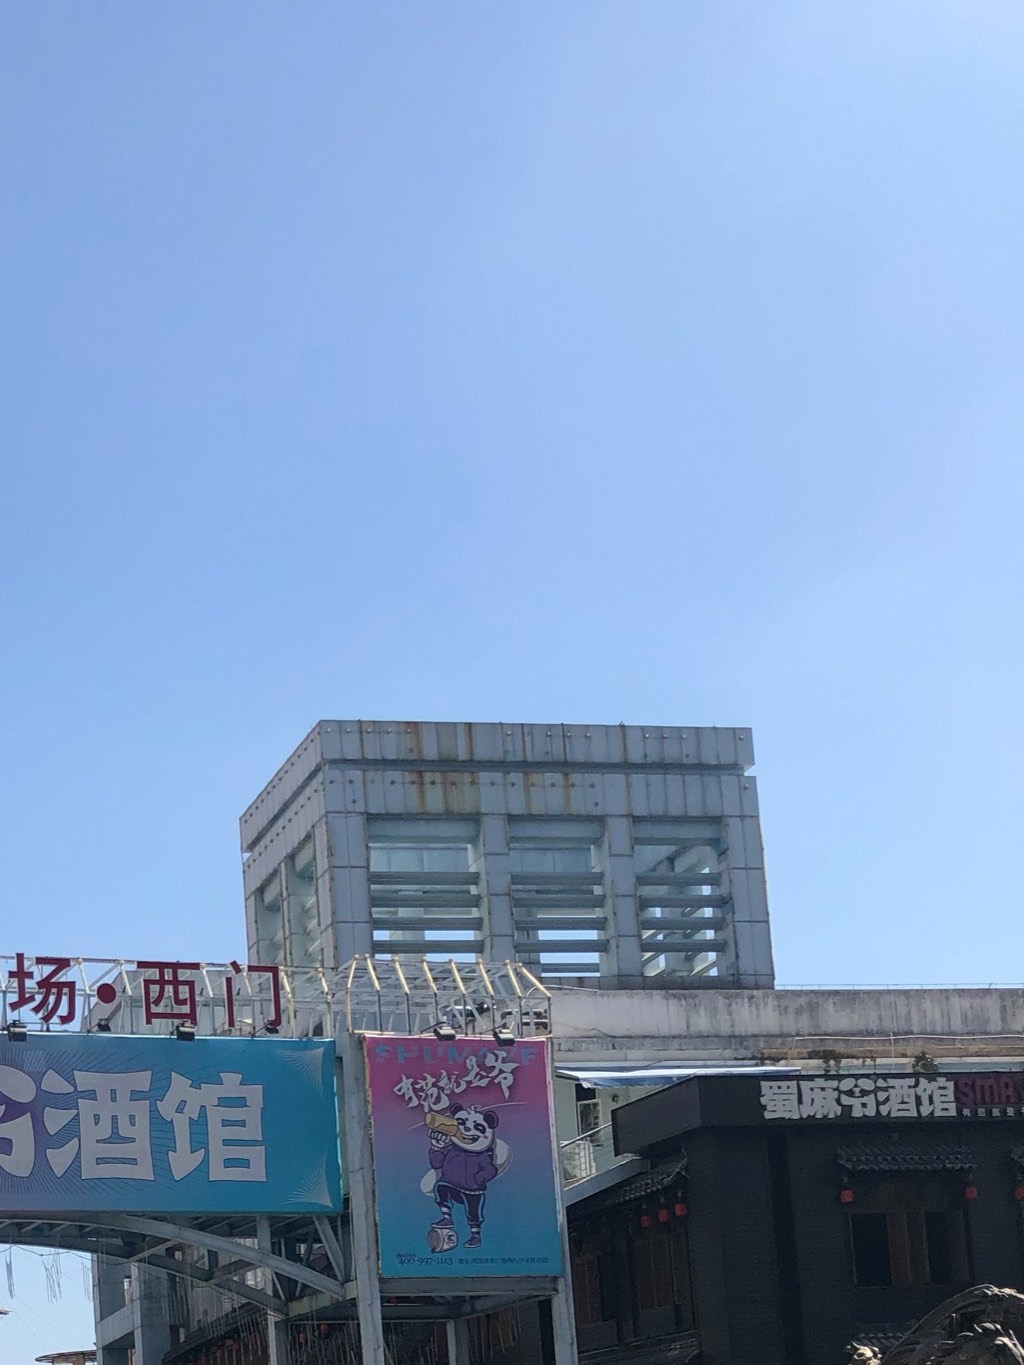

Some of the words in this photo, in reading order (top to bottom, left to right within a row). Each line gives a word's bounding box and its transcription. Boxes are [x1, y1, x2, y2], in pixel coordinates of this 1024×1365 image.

[760, 1077, 957, 1119] 蜀麻爷酒馆
